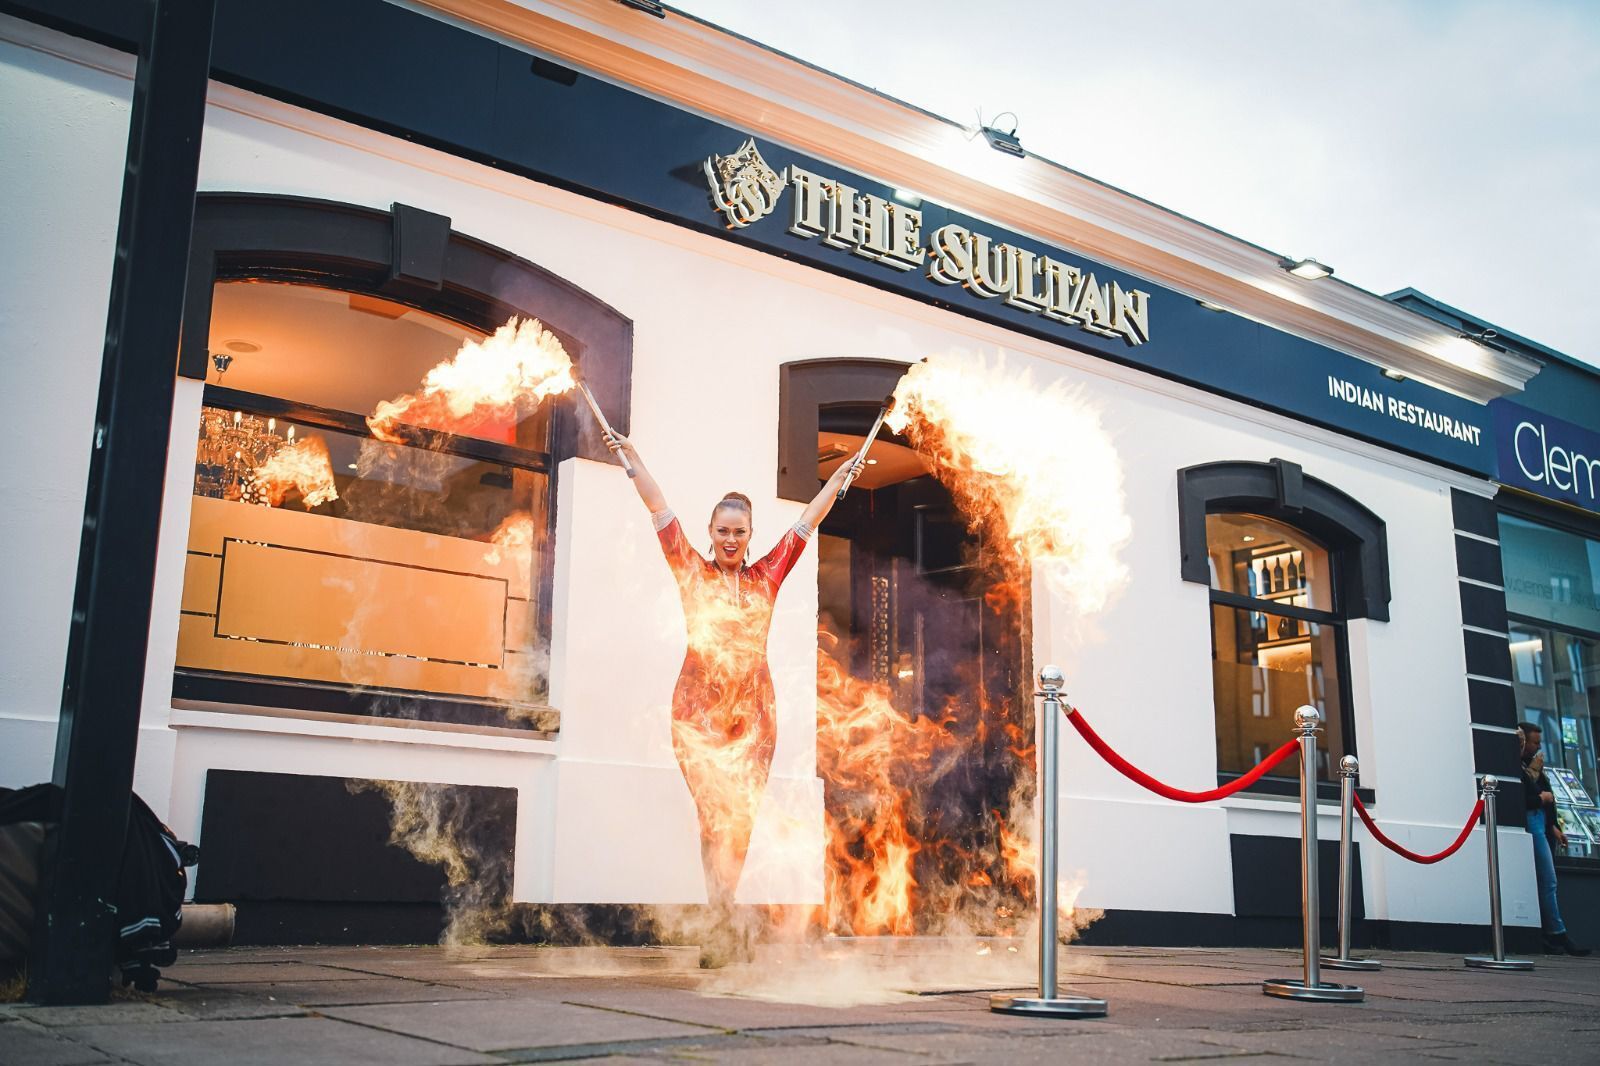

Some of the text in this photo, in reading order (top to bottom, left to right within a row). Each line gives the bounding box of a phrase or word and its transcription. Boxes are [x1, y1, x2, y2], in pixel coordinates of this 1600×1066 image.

[786, 163, 1151, 346] THE SULTAN
[1328, 376, 1481, 446] INDIAN RESTAURANT
